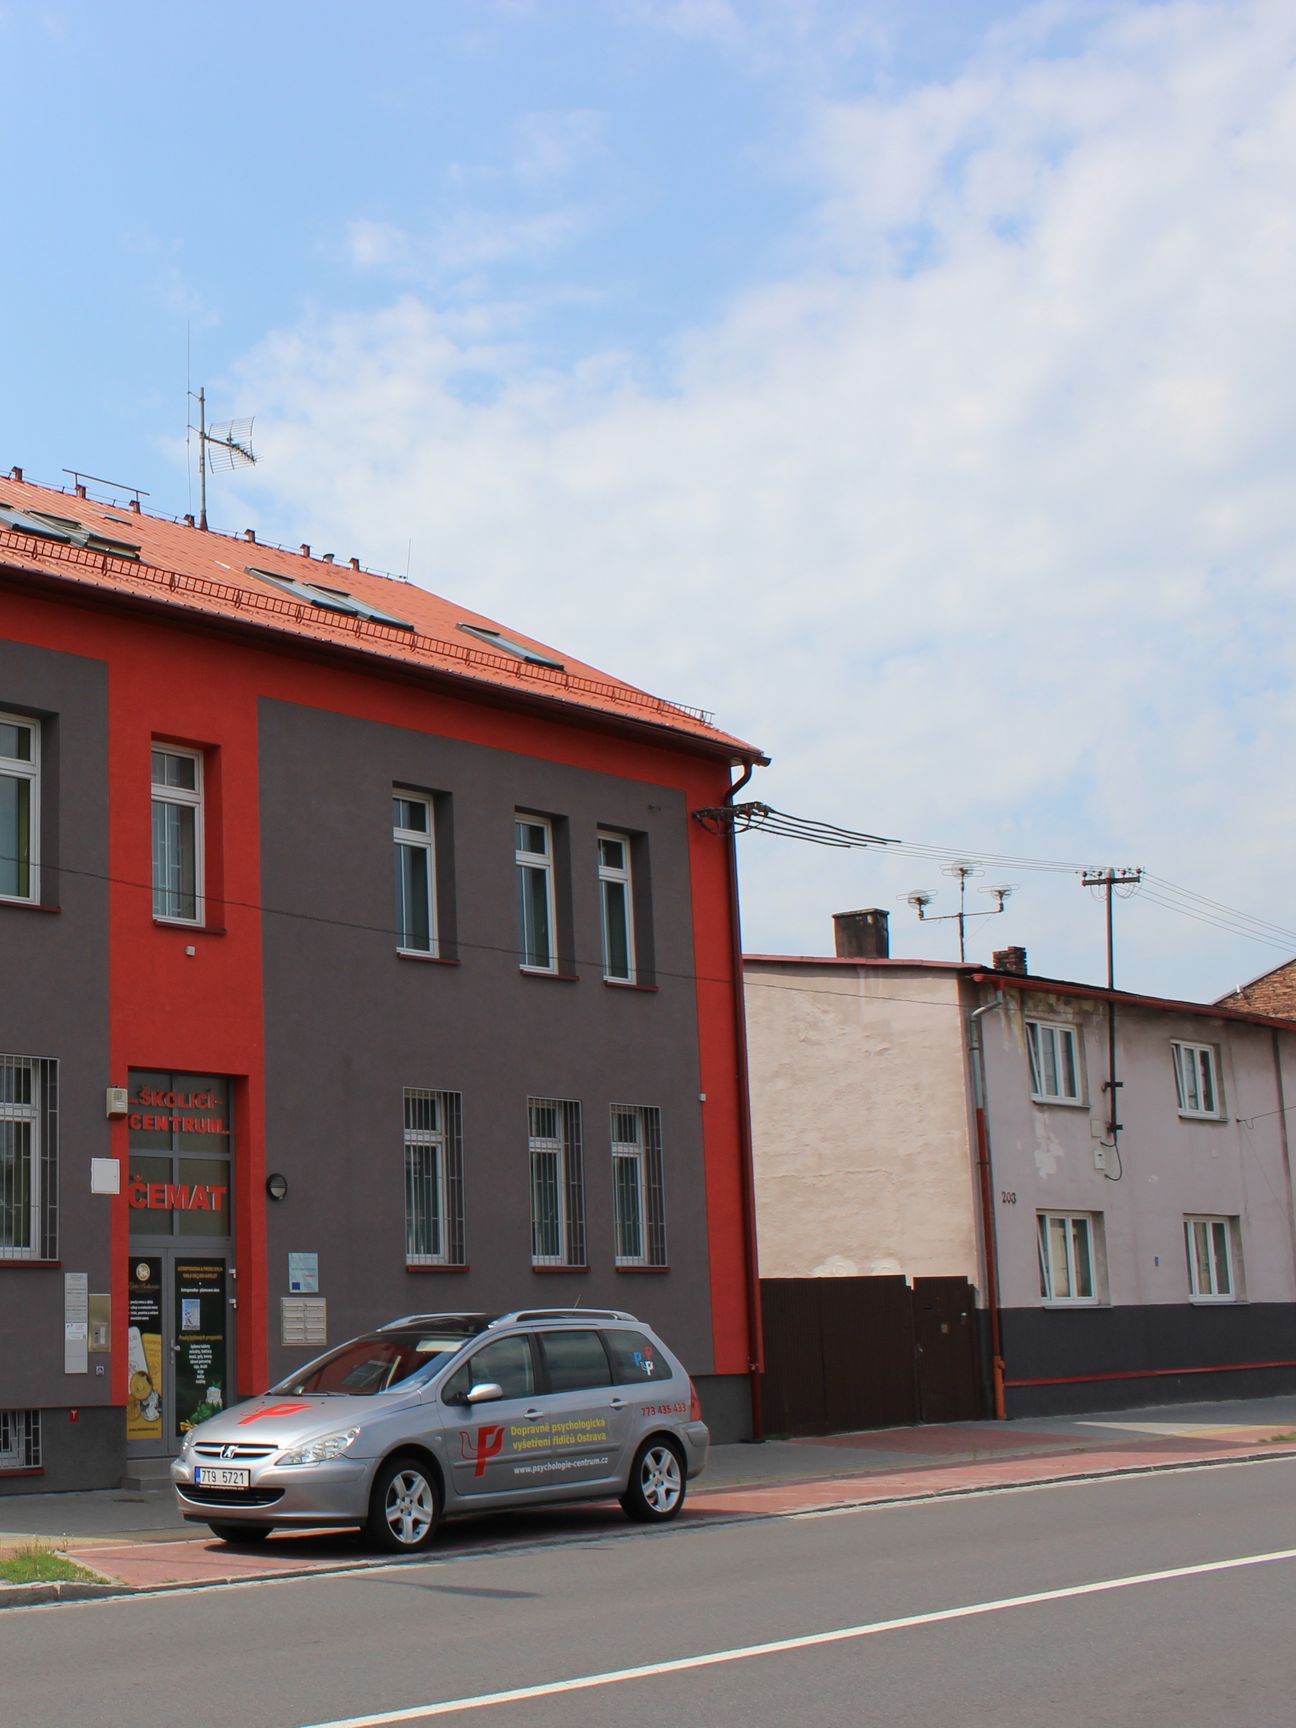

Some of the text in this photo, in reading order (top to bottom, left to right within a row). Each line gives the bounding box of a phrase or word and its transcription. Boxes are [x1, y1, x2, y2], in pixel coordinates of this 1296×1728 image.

[140, 1084, 215, 1109] ŠKOLICÍ
[129, 1113, 224, 1134] CENTRUM
[129, 1173, 227, 1211] ČEMAT
[641, 1403, 687, 1416] 773 435 433
[512, 1435, 551, 1451] vyšetření
[577, 1432, 607, 1443] Ostrava
[514, 1457, 609, 1474] www.psychologie-centrum.cz
[202, 1470, 244, 1484] 7T9 5721
